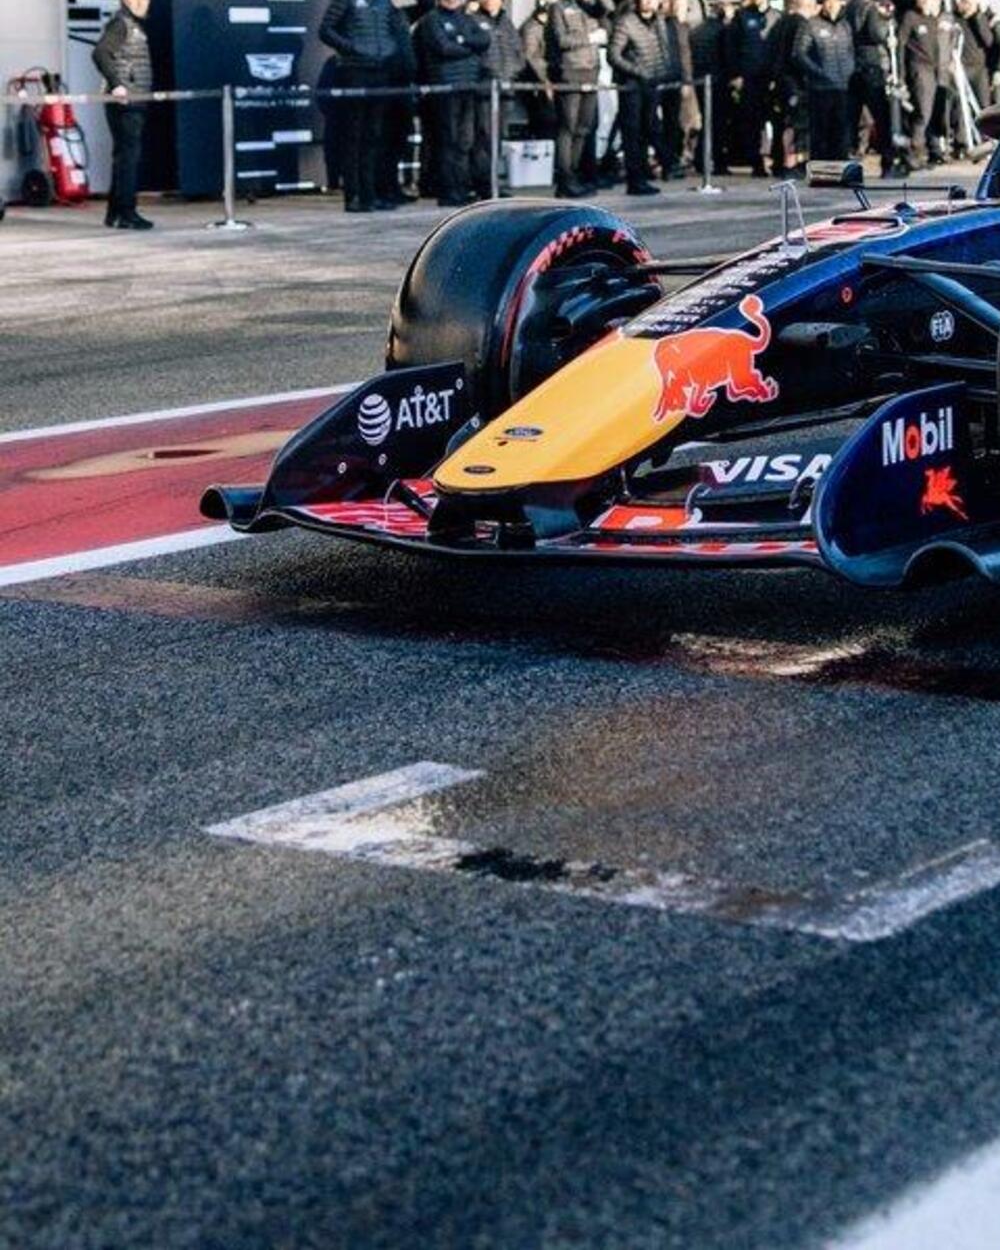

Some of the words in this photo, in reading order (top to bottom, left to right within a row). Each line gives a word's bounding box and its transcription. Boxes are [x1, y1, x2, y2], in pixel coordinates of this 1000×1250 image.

[396, 389, 454, 430] AT&T
[882, 406, 953, 466] Mobil
[702, 454, 832, 483] VISA
